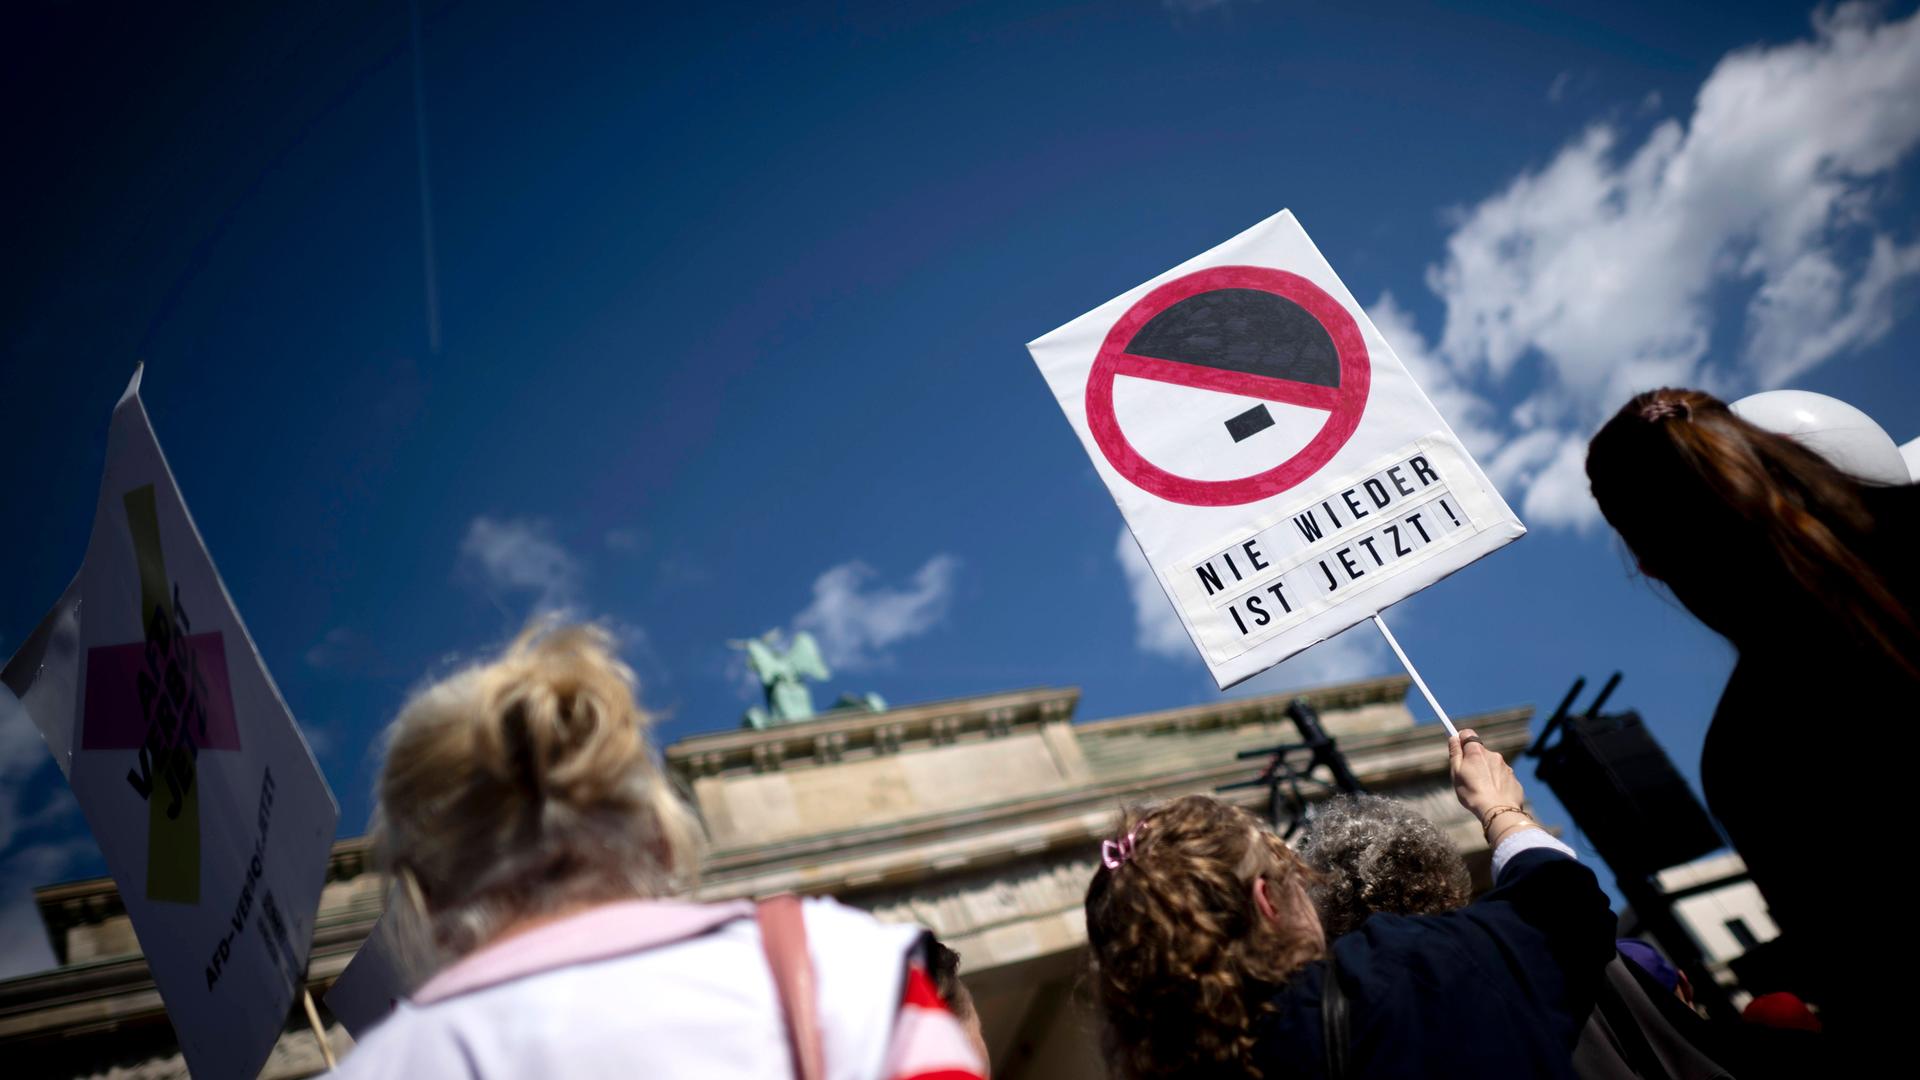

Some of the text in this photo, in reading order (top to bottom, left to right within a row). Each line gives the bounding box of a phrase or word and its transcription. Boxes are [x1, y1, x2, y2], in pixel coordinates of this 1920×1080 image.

[1195, 455, 1440, 596] NIE WIEDER
[1229, 582, 1292, 635] IST
[1318, 513, 1432, 592] JETZT
